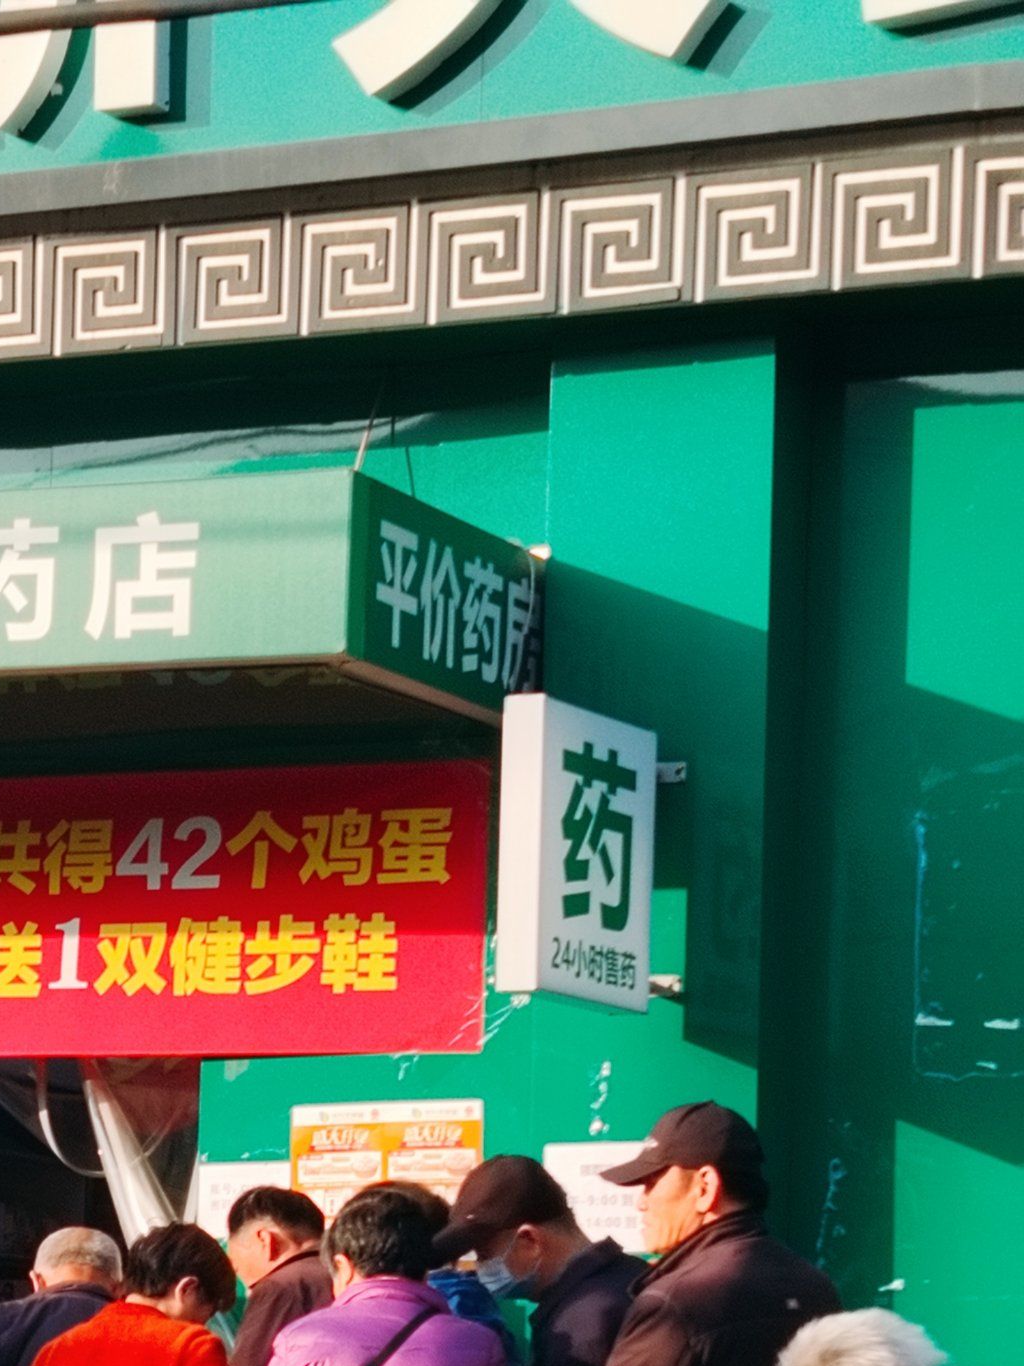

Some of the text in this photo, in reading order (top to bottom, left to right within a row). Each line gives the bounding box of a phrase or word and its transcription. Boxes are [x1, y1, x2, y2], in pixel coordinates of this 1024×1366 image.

[561, 742, 637, 932] 药
[551, 936, 637, 991] 24小时售药
